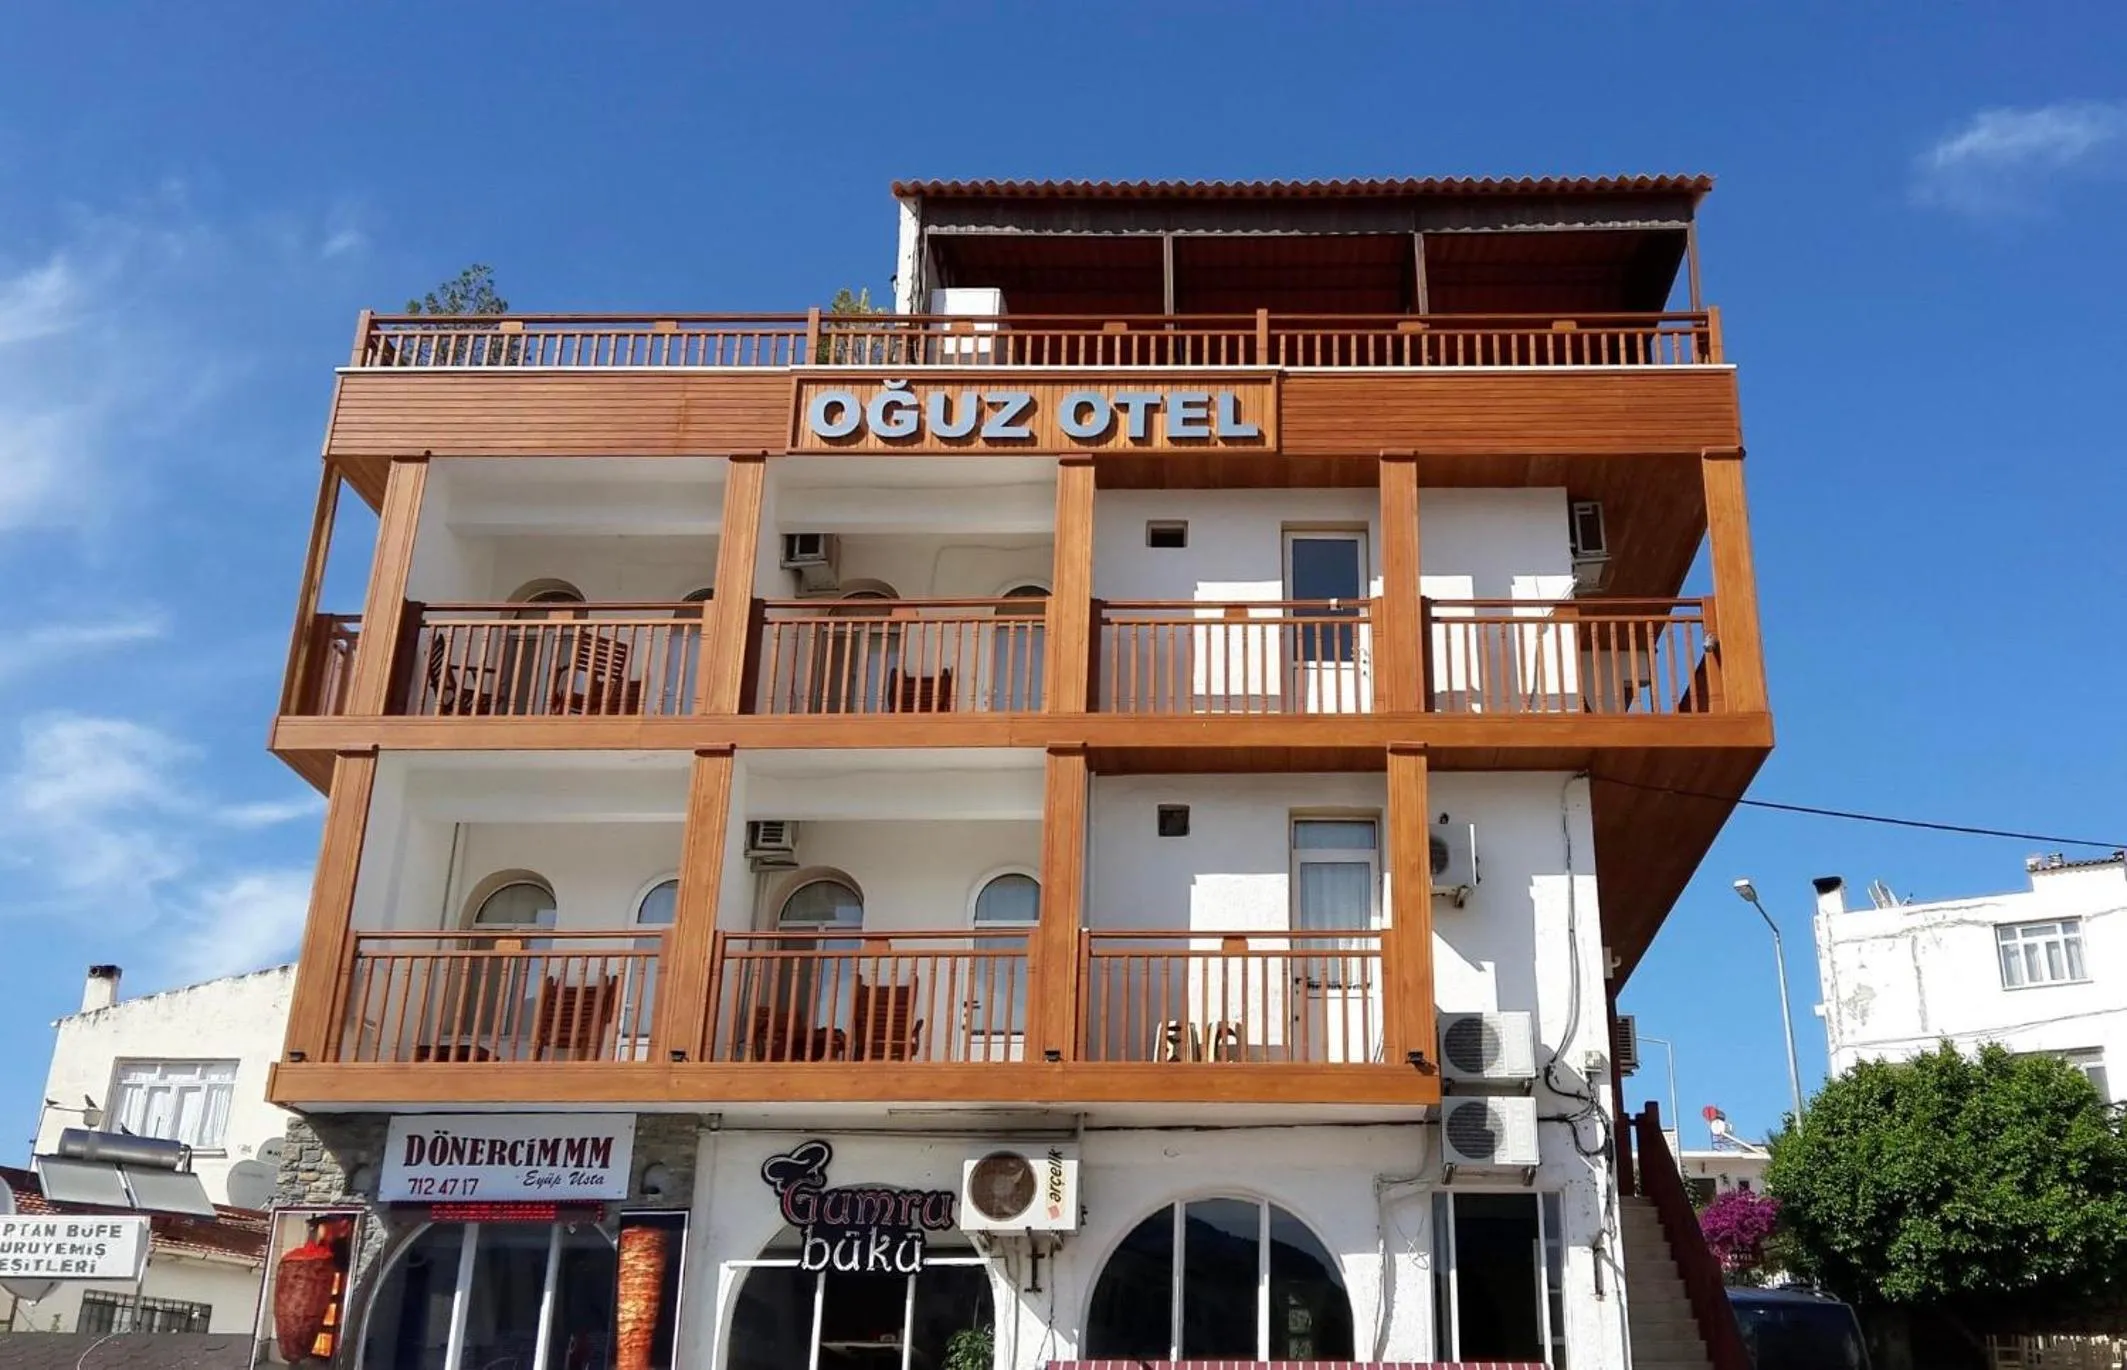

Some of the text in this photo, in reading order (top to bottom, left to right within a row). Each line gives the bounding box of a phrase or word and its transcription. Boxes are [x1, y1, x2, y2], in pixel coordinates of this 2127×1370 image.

[809, 379, 1259, 438] OĞUZ OTEL
[408, 1177, 479, 1195] 712 47 17
[523, 1169, 604, 1190] Eyüp Usta
[66, 1224, 123, 1238] BÜFE
[0, 1241, 107, 1259] URUYEMİŞ
